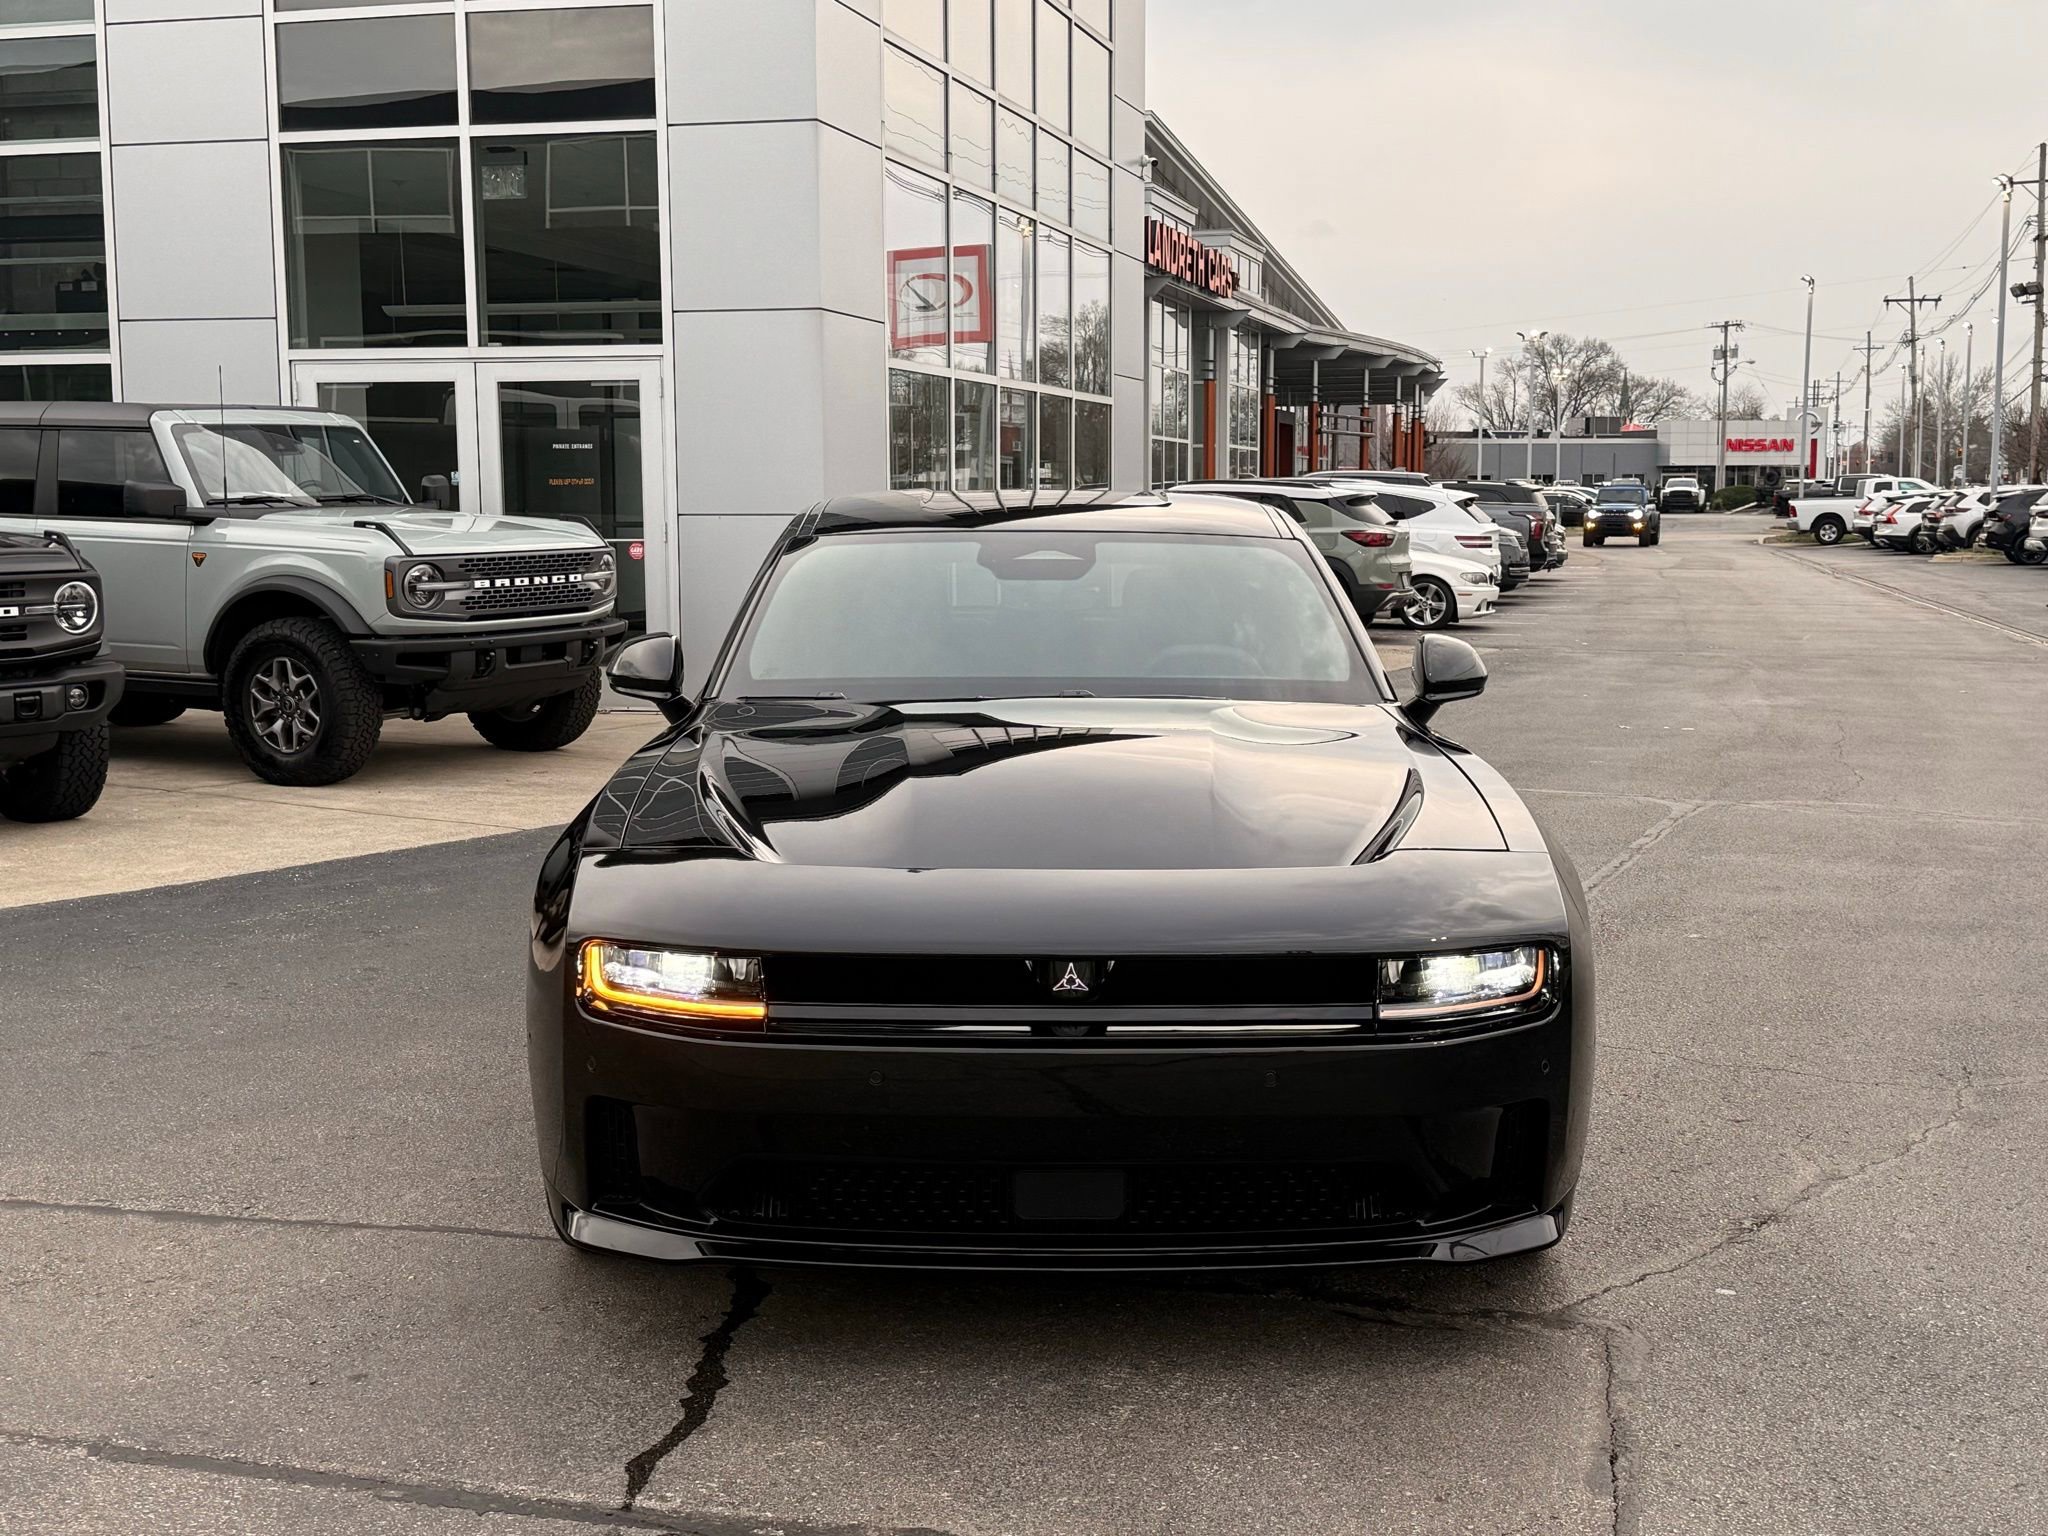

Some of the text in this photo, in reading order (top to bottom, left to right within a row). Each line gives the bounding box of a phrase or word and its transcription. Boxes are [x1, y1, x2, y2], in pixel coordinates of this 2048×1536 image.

[1145, 216, 1232, 298] LANDRETH CARS
[1726, 438, 1795, 452] NISSAN
[474, 573, 582, 588] BRONCO
